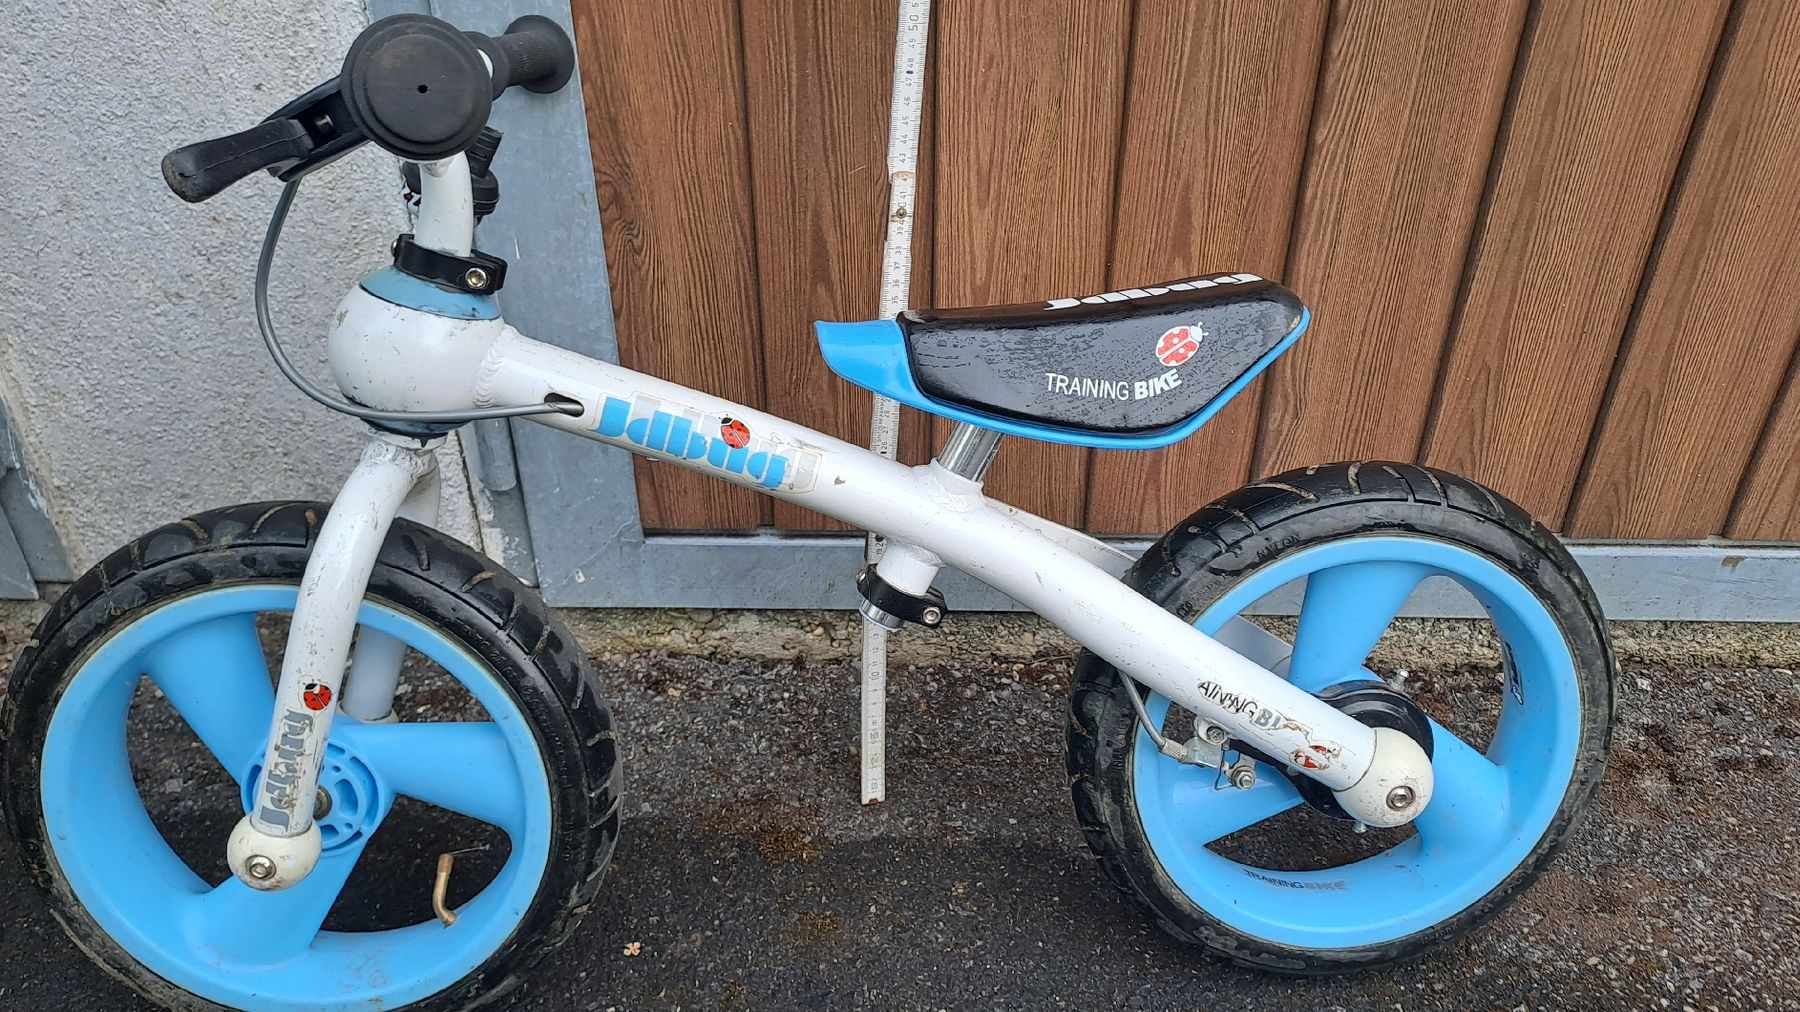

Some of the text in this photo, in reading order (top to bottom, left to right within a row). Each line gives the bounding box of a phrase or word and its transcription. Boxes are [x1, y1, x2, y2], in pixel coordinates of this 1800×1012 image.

[908, 14, 919, 32] 50
[908, 38, 917, 49] 49
[907, 57, 915, 68] 48
[905, 77, 913, 88] 47
[904, 96, 911, 107] 46
[902, 115, 910, 126] 45
[900, 134, 908, 144] 44
[898, 153, 907, 164] 43
[899, 191, 907, 200] 41
[896, 226, 904, 236] 39
[895, 245, 902, 255] 38
[893, 261, 901, 271] 37
[892, 278, 900, 288] 36
[891, 295, 899, 305] 35
[1044, 368, 1183, 401] TRAINING BIKE
[880, 440, 888, 450] 26
[1243, 868, 1346, 891] TRAINING BIKE
